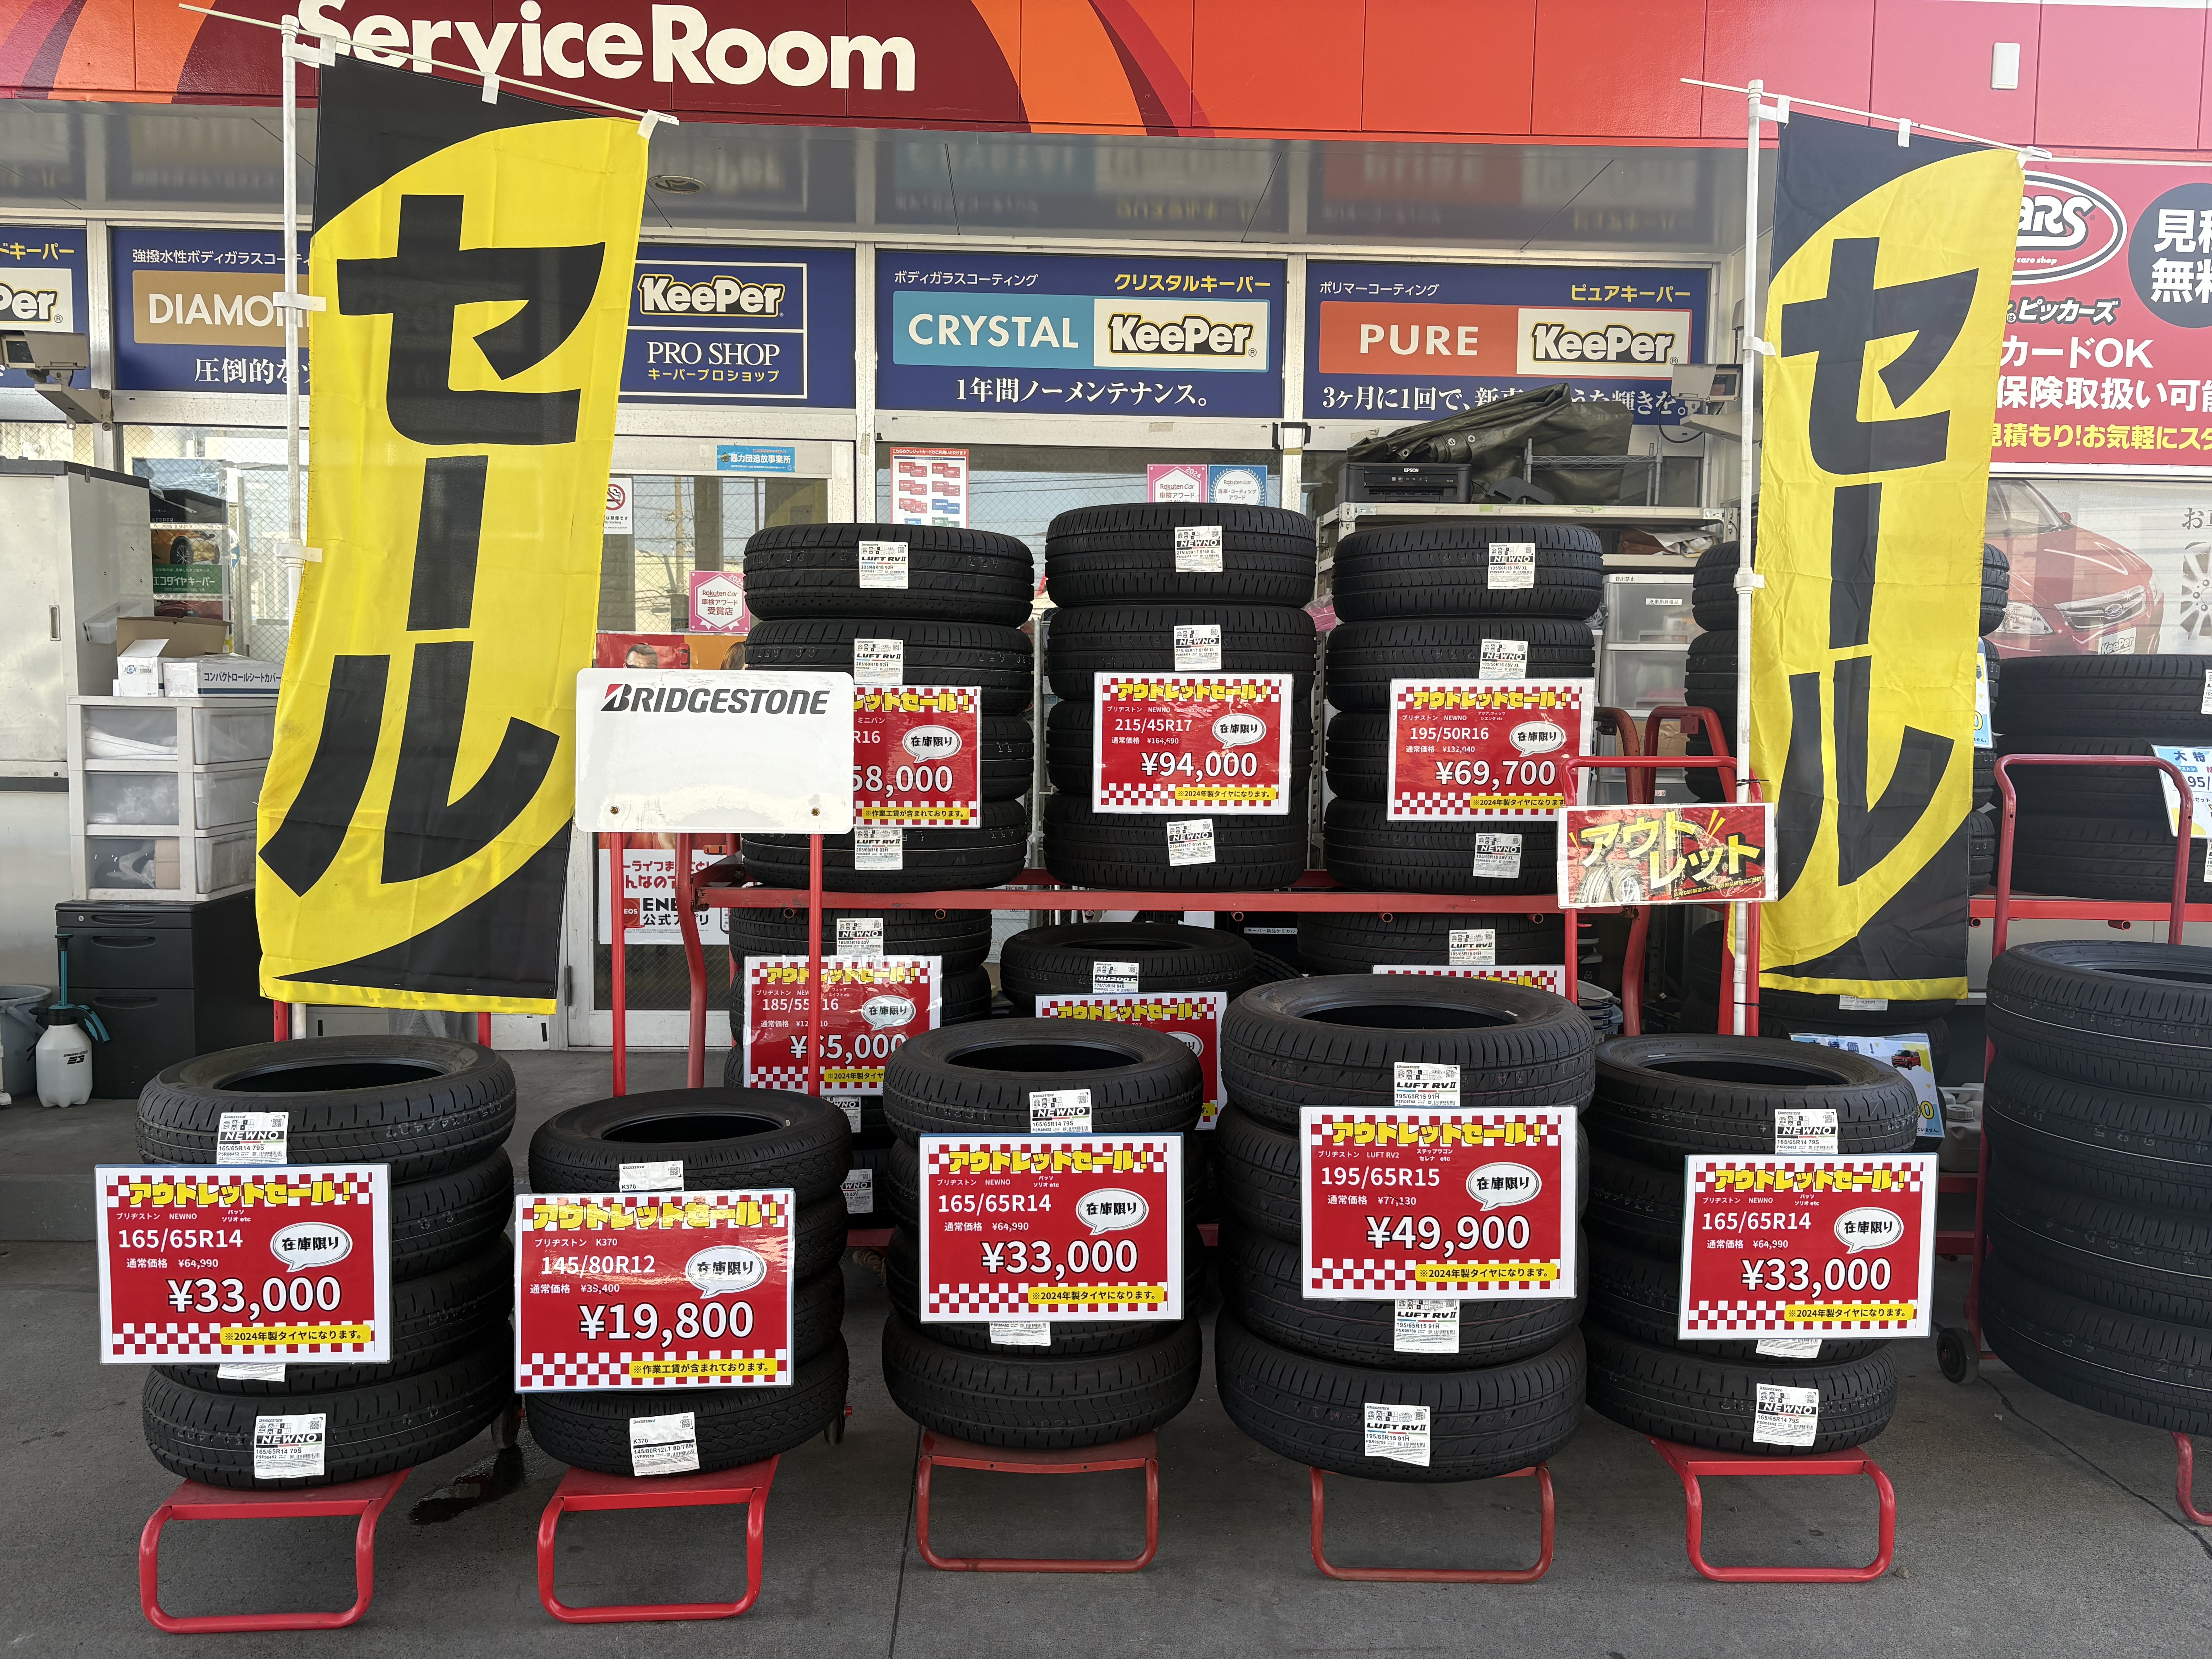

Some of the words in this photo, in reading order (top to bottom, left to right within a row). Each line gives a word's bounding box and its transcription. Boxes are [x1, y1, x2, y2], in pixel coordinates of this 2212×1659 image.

[894, 270, 1038, 287] ボディガラスコーティング
[1114, 274, 1271, 292] クリスタルキーパー
[640, 276, 783, 315] KeePer
[1319, 282, 1440, 296] ポリマーコーティング
[1571, 284, 1691, 303] ピュアキーパー
[149, 293, 309, 328] DIAMO
[2019, 299, 2118, 323] ピッカーズ
[908, 314, 1079, 349] CRYSTAL
[1109, 313, 1253, 355] KeePer
[1360, 324, 1479, 357] PURE
[1532, 323, 1675, 364] KeePer
[647, 342, 702, 364] PRO
[709, 343, 780, 366] SHOP
[648, 368, 780, 382] キーパープロショップ
[956, 378, 1207, 407] 1年間ノーメンテナンス。
[1185, 467, 1201, 478] 2024
[258, 194, 605, 898] セール
[1779, 237, 1979, 902] セール
[728, 574, 743, 587] 202
[707, 607, 733, 616] 受賞店
[204, 672, 282, 682] コンパクトロールシートカバー
[601, 684, 830, 714] BRIDGESTONE
[1117, 683, 1267, 700] アウトレットセール!
[1413, 691, 1566, 708] アウトレットセール!
[1115, 718, 1192, 734] 215/45R17
[1220, 724, 1258, 733] 在庫限り
[911, 736, 952, 747] 在庫限り
[1410, 727, 1489, 742] 195/50R16
[1517, 732, 1556, 741] 在庫限り
[1140, 752, 1257, 783] ¥94,000
[1436, 760, 1556, 792] ¥69,700
[1173, 832, 1209, 841] NEWNO
[1581, 811, 1698, 867] アウト
[1650, 835, 1760, 890] レット
[763, 998, 839, 1013] 185/5516
[1058, 1003, 1202, 1020] アウトレットセール!
[1038, 1108, 1085, 1116] NEWNO
[225, 1131, 279, 1140] NEWNO
[1332, 1121, 1541, 1144] アウトレットセール!
[948, 1150, 1148, 1173] アウトレットセール!
[1317, 1151, 1360, 1159] ブリヂストン
[1321, 1166, 1440, 1189] 195/65R15
[1477, 1176, 1529, 1190] 在庫限り
[1714, 1169, 1905, 1190] アウトレットセール!
[128, 1181, 351, 1206] アウトレットセール!
[1327, 1195, 1367, 1205] 通常価格
[1377, 1195, 1417, 1207] ¥77,130
[938, 1193, 1051, 1216] 165/65R14
[1086, 1202, 1137, 1216] 在庫限り
[116, 1212, 160, 1221] ブリヂストン
[533, 1200, 778, 1230] アウトレットセール!
[1702, 1211, 1811, 1233] 165/65R14
[944, 1222, 982, 1231] 通常価格
[992, 1222, 1029, 1233] ¥64,990
[1844, 1221, 1893, 1234] 在庫限り
[119, 1228, 243, 1252] 165/65R14
[282, 1237, 340, 1251] 在庫限り
[535, 1238, 587, 1247] ブリヂストン
[596, 1237, 618, 1247] K370
[1365, 1214, 1530, 1259] ¥49,900
[1707, 1239, 1743, 1249] 通常価格
[1753, 1240, 1788, 1250] ¥64,990
[126, 1258, 168, 1269] 通常価格
[178, 1259, 219, 1270] ¥64,990
[541, 1255, 655, 1278] 145/80R12
[980, 1238, 1138, 1282] ¥33,000
[696, 1261, 754, 1276] 在庫限り
[1419, 1267, 1551, 1278] ※2024年製タイヤになります。
[1741, 1257, 1891, 1300] ¥33,000
[580, 1283, 620, 1295] ¥39,400
[1032, 1290, 1156, 1301] ※2024年製タイヤになります。
[166, 1276, 341, 1321] ¥33,000
[1788, 1308, 1908, 1318] ※2024年製タイヤになります。
[578, 1300, 754, 1349] ¥19,800
[224, 1329, 362, 1341] ※2024年製タイヤになります。
[1764, 1403, 1812, 1414] NEWNO
[261, 1434, 317, 1444] NEWNO
[634, 1446, 671, 1455] 145/80R12LT
